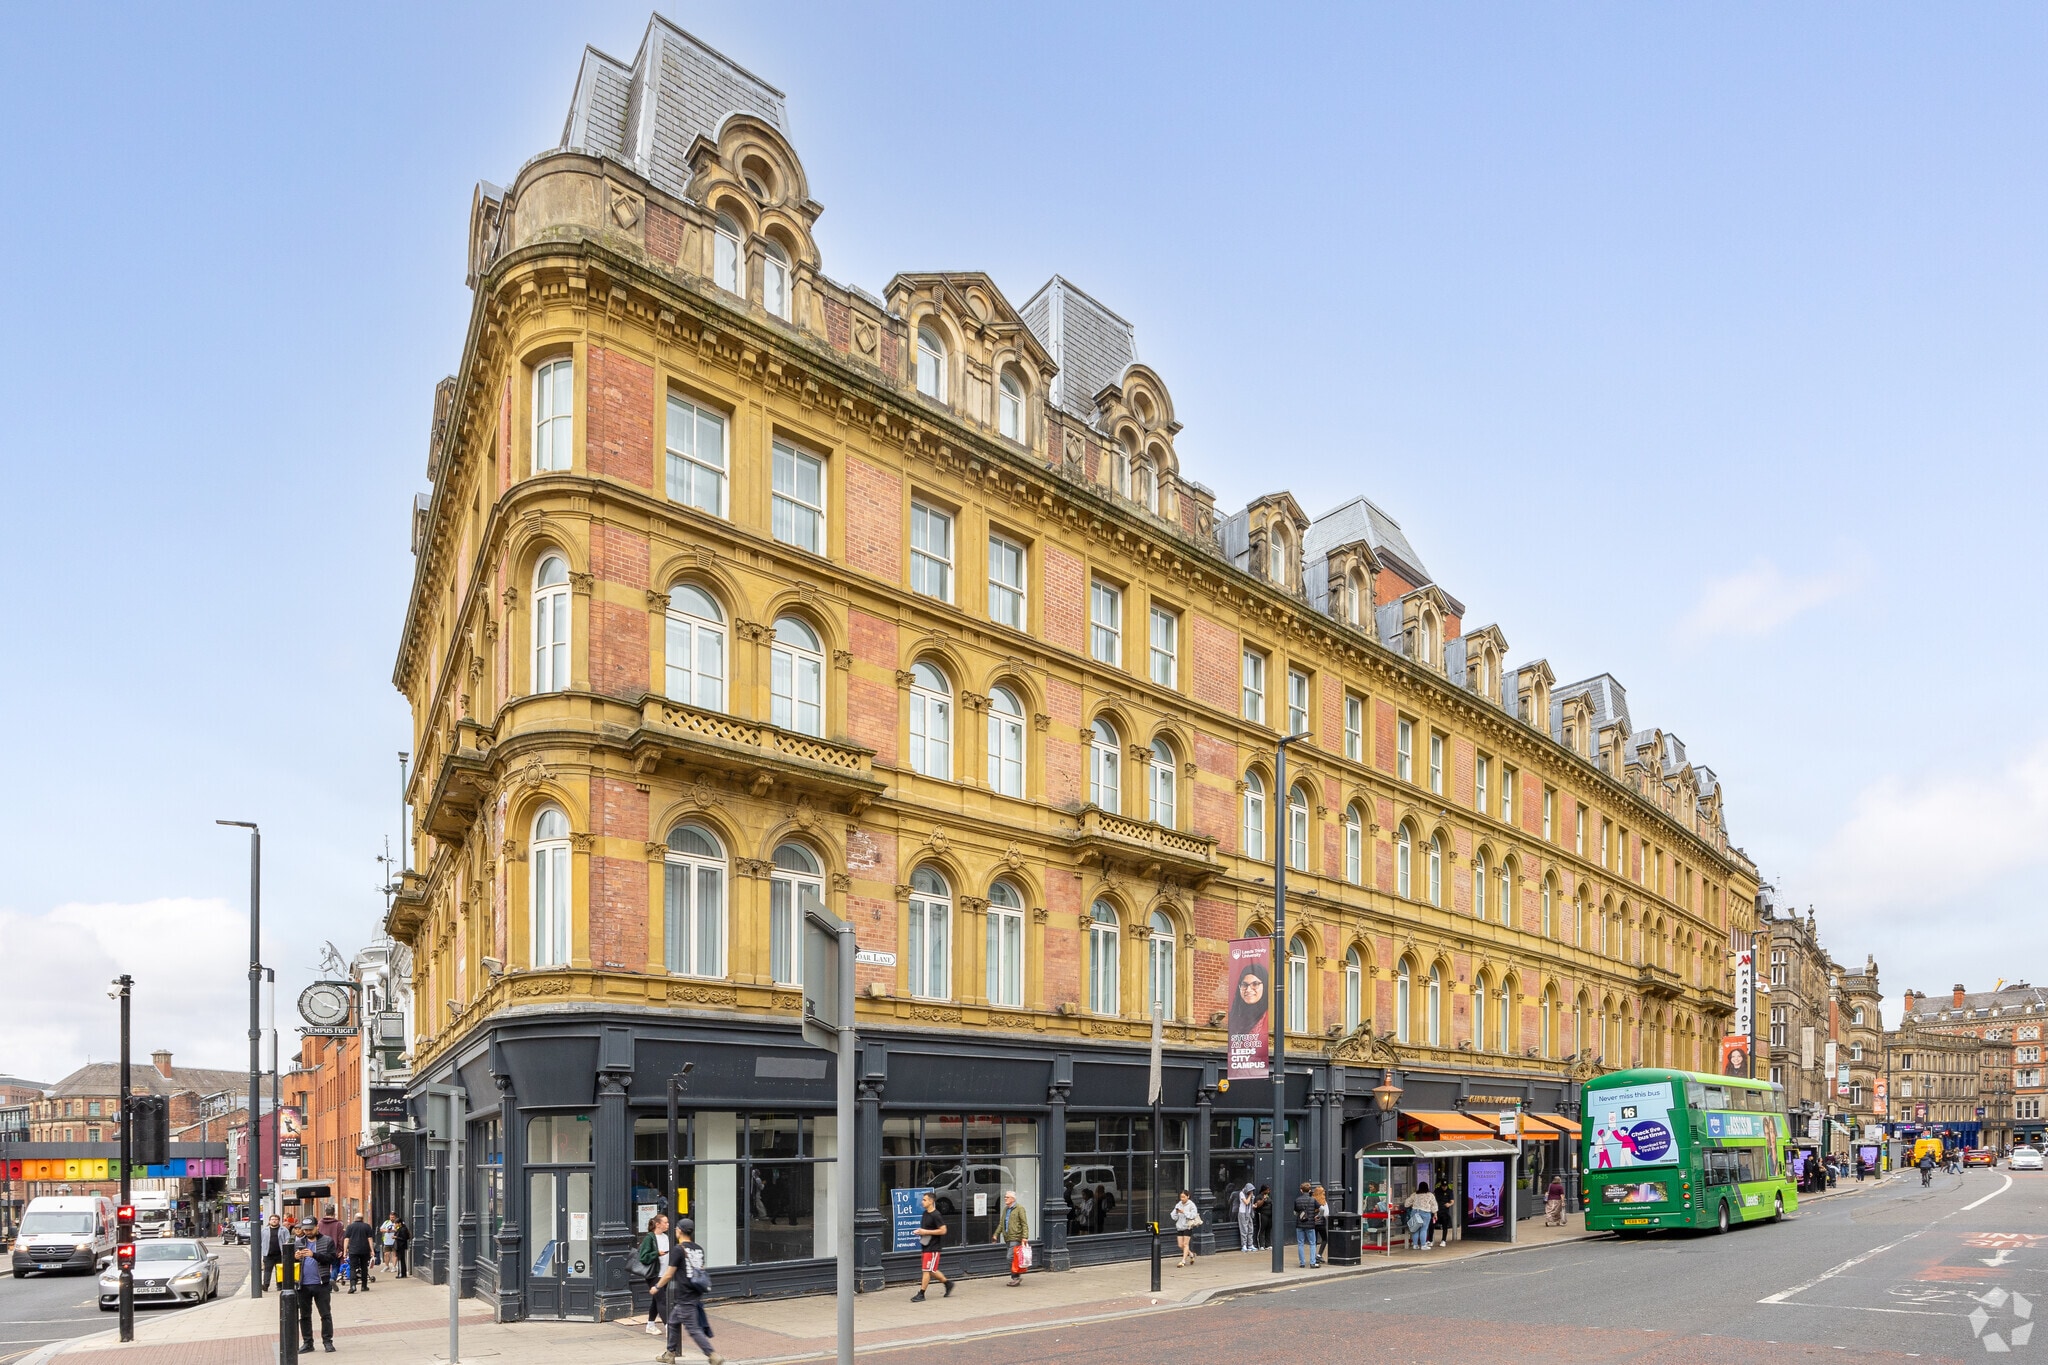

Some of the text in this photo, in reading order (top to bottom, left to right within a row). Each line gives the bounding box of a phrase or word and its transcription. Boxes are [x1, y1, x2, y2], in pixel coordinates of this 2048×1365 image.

[856, 953, 892, 963] OAR LANE
[1741, 969, 1749, 1035] MARRIOT
[334, 1026, 355, 1034] FUGIT
[1230, 1033, 1259, 1042] STUDY
[1230, 1040, 1262, 1049] AT OUR
[1231, 1047, 1257, 1055] LEEDS
[1231, 1055, 1251, 1063] CITY
[1231, 1061, 1266, 1070] CAMPUS
[1647, 1089, 1661, 1097] bus
[1622, 1107, 1635, 1118] 16
[1631, 1129, 1650, 1138] Check
[1637, 1130, 1667, 1141] bus times
[1638, 1141, 1659, 1150] Download
[896, 1191, 909, 1203] To
[898, 1204, 913, 1215] Let
